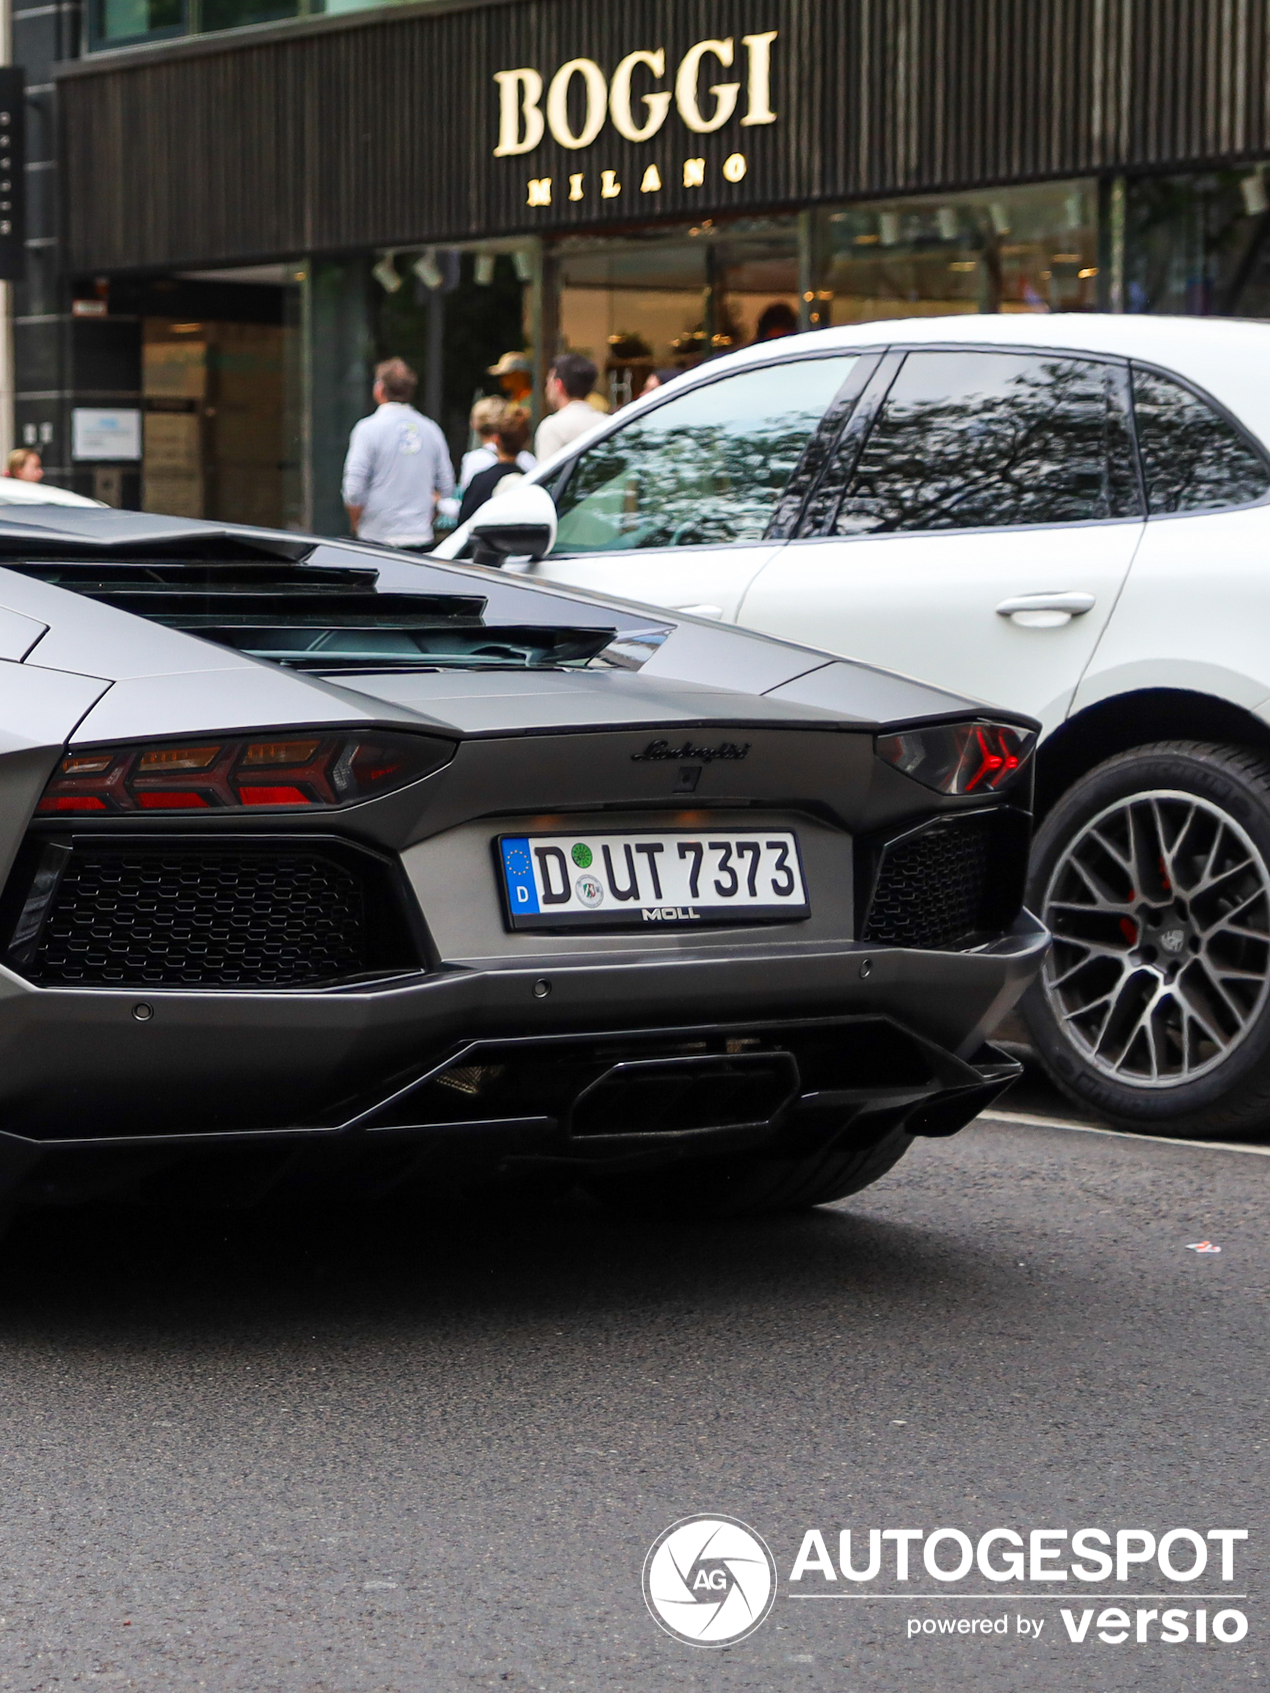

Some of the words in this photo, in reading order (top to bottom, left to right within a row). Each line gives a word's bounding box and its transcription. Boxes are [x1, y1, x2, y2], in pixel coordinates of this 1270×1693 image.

[493, 30, 778, 157] BOGGI
[527, 153, 747, 207] MILANO
[516, 885, 529, 903] D
[602, 843, 664, 901] UT
[677, 841, 795, 898] 7373
[641, 907, 701, 921] MOLL
